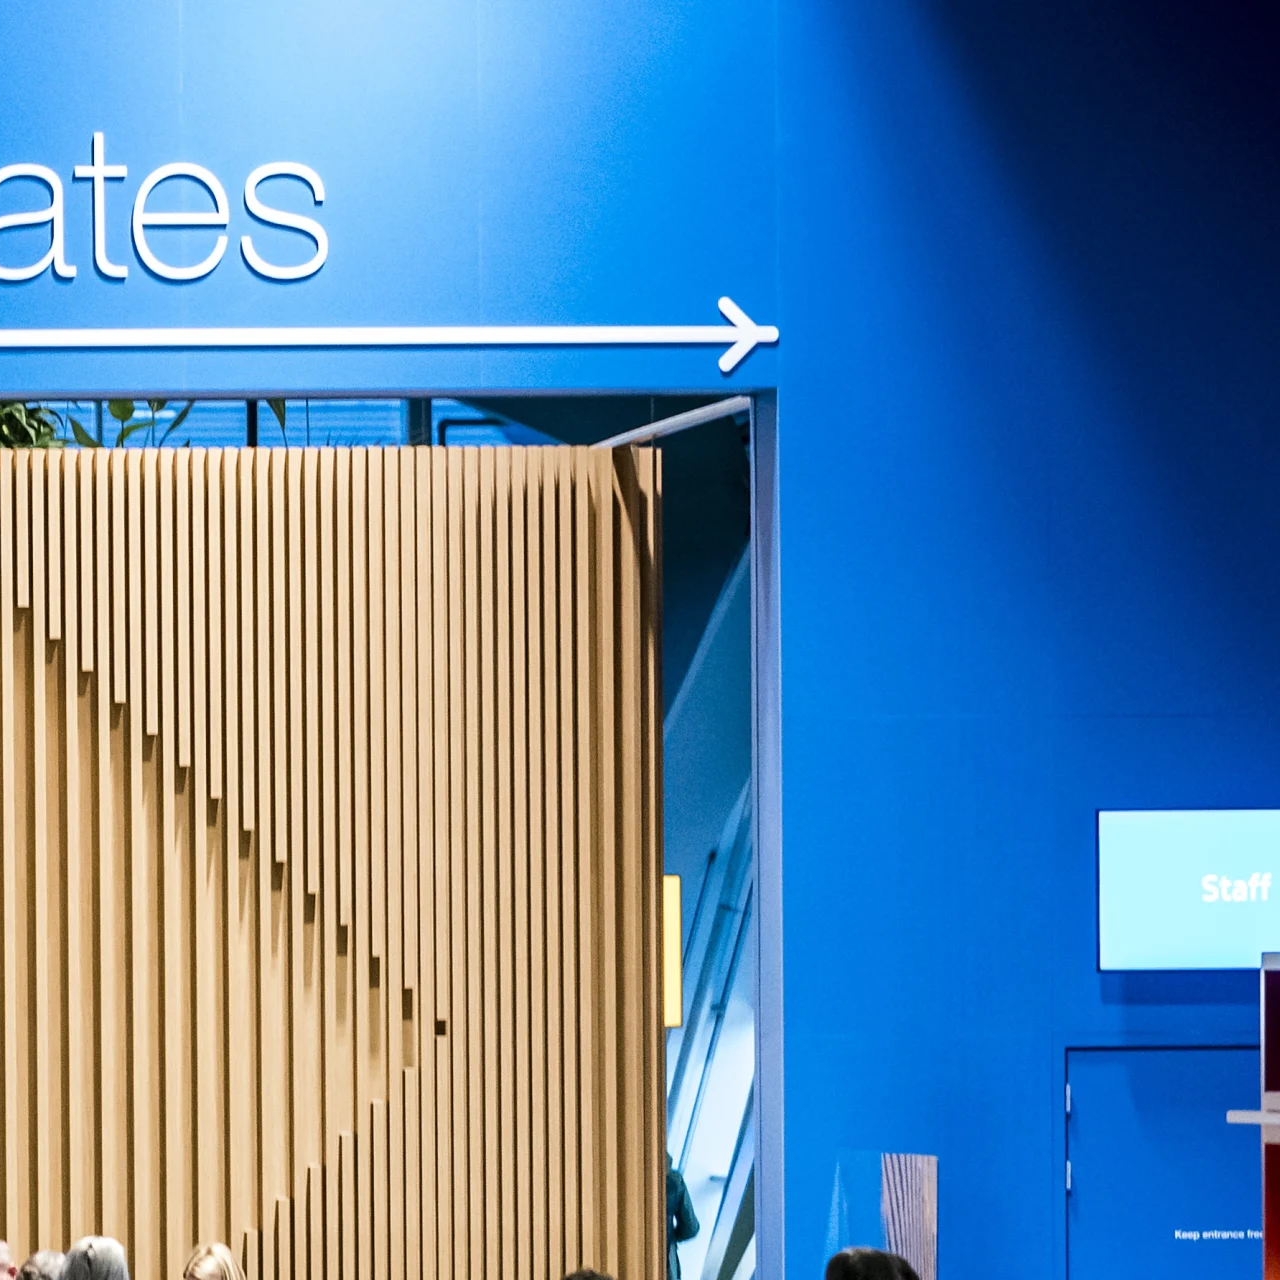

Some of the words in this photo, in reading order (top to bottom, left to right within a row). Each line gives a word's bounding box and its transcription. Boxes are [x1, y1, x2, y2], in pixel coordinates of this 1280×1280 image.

[1201, 872, 1273, 903] Staff
[1174, 1228, 1201, 1241] Keep
[1202, 1229, 1245, 1240] entrance
